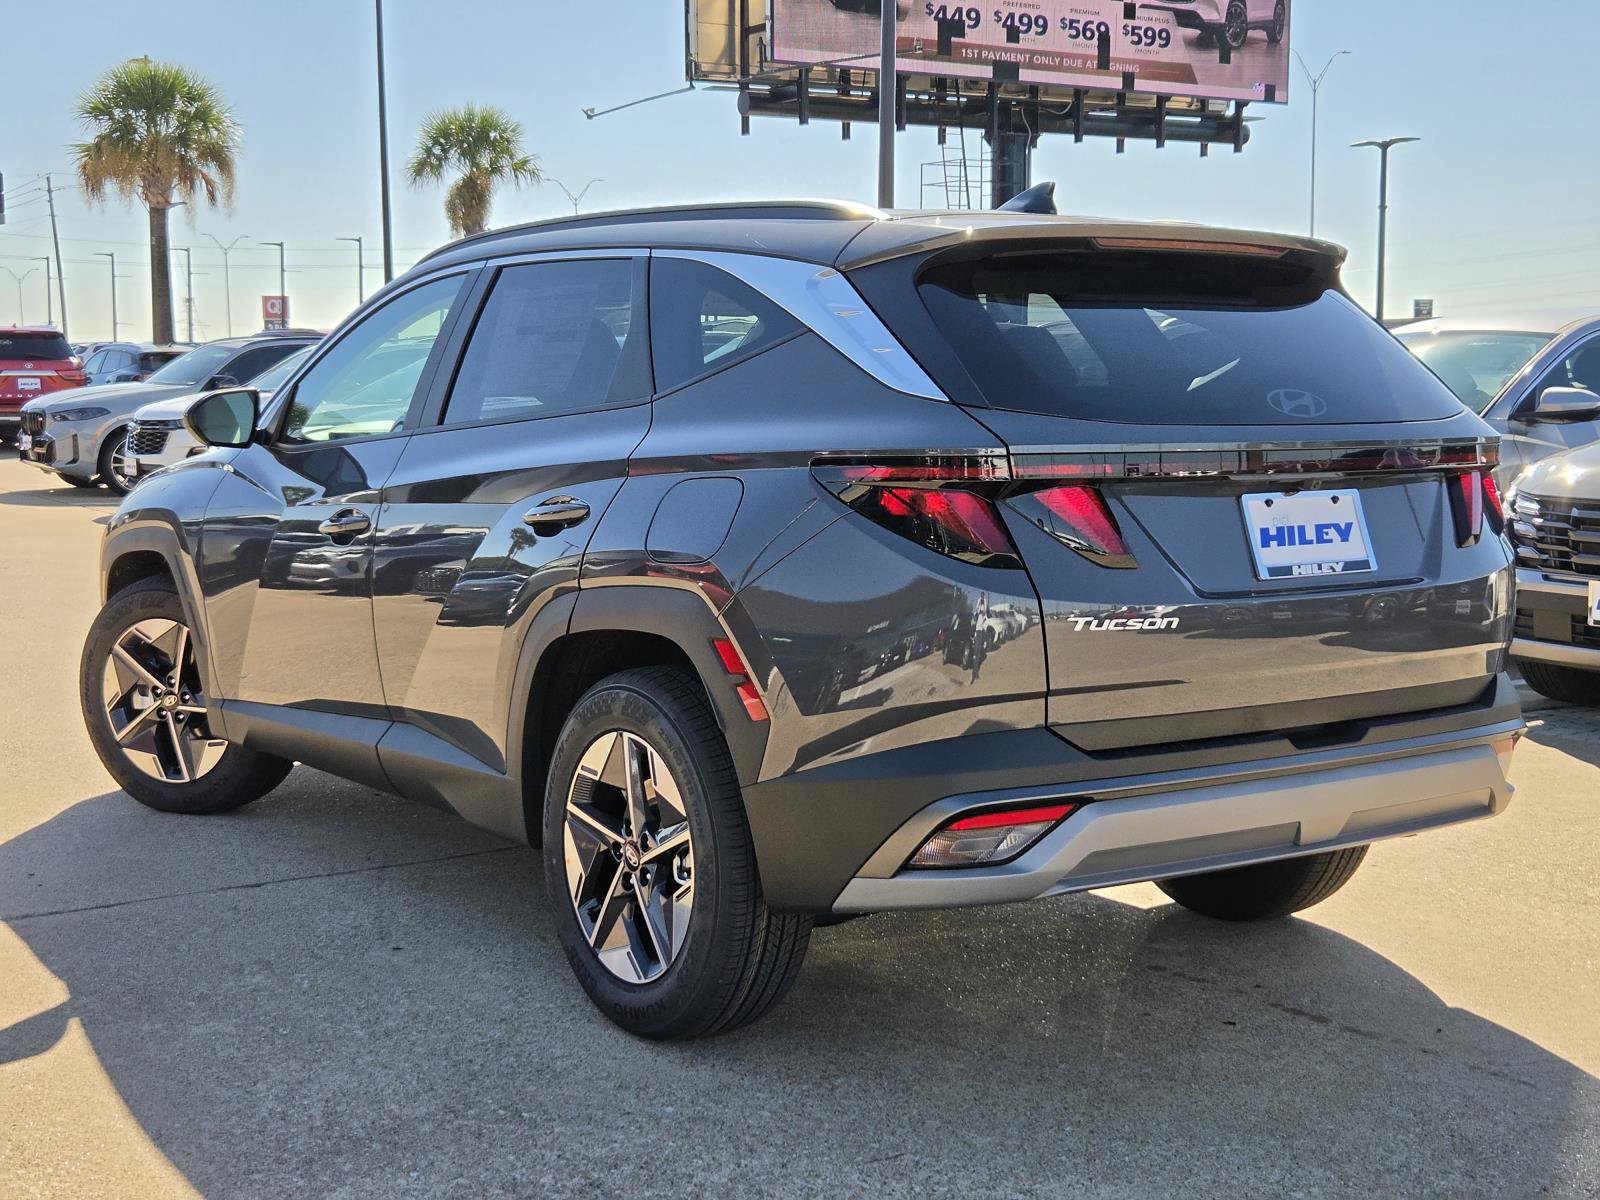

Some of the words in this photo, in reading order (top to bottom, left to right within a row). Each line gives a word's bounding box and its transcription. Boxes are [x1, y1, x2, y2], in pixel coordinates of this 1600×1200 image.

[1002, 1, 1041, 9] PREFERRED
[1070, 8, 1100, 16] PREMIUM
[993, 9, 1048, 36] $499
[1122, 23, 1171, 48] $599
[961, 48, 979, 58] 1ST
[981, 51, 1031, 63] PAYMENT
[1033, 55, 1061, 65] ONLY
[1063, 58, 1083, 68] DUE
[1085, 60, 1098, 69] AT
[1259, 521, 1354, 549] HILEY
[1292, 561, 1345, 575] HILEY
